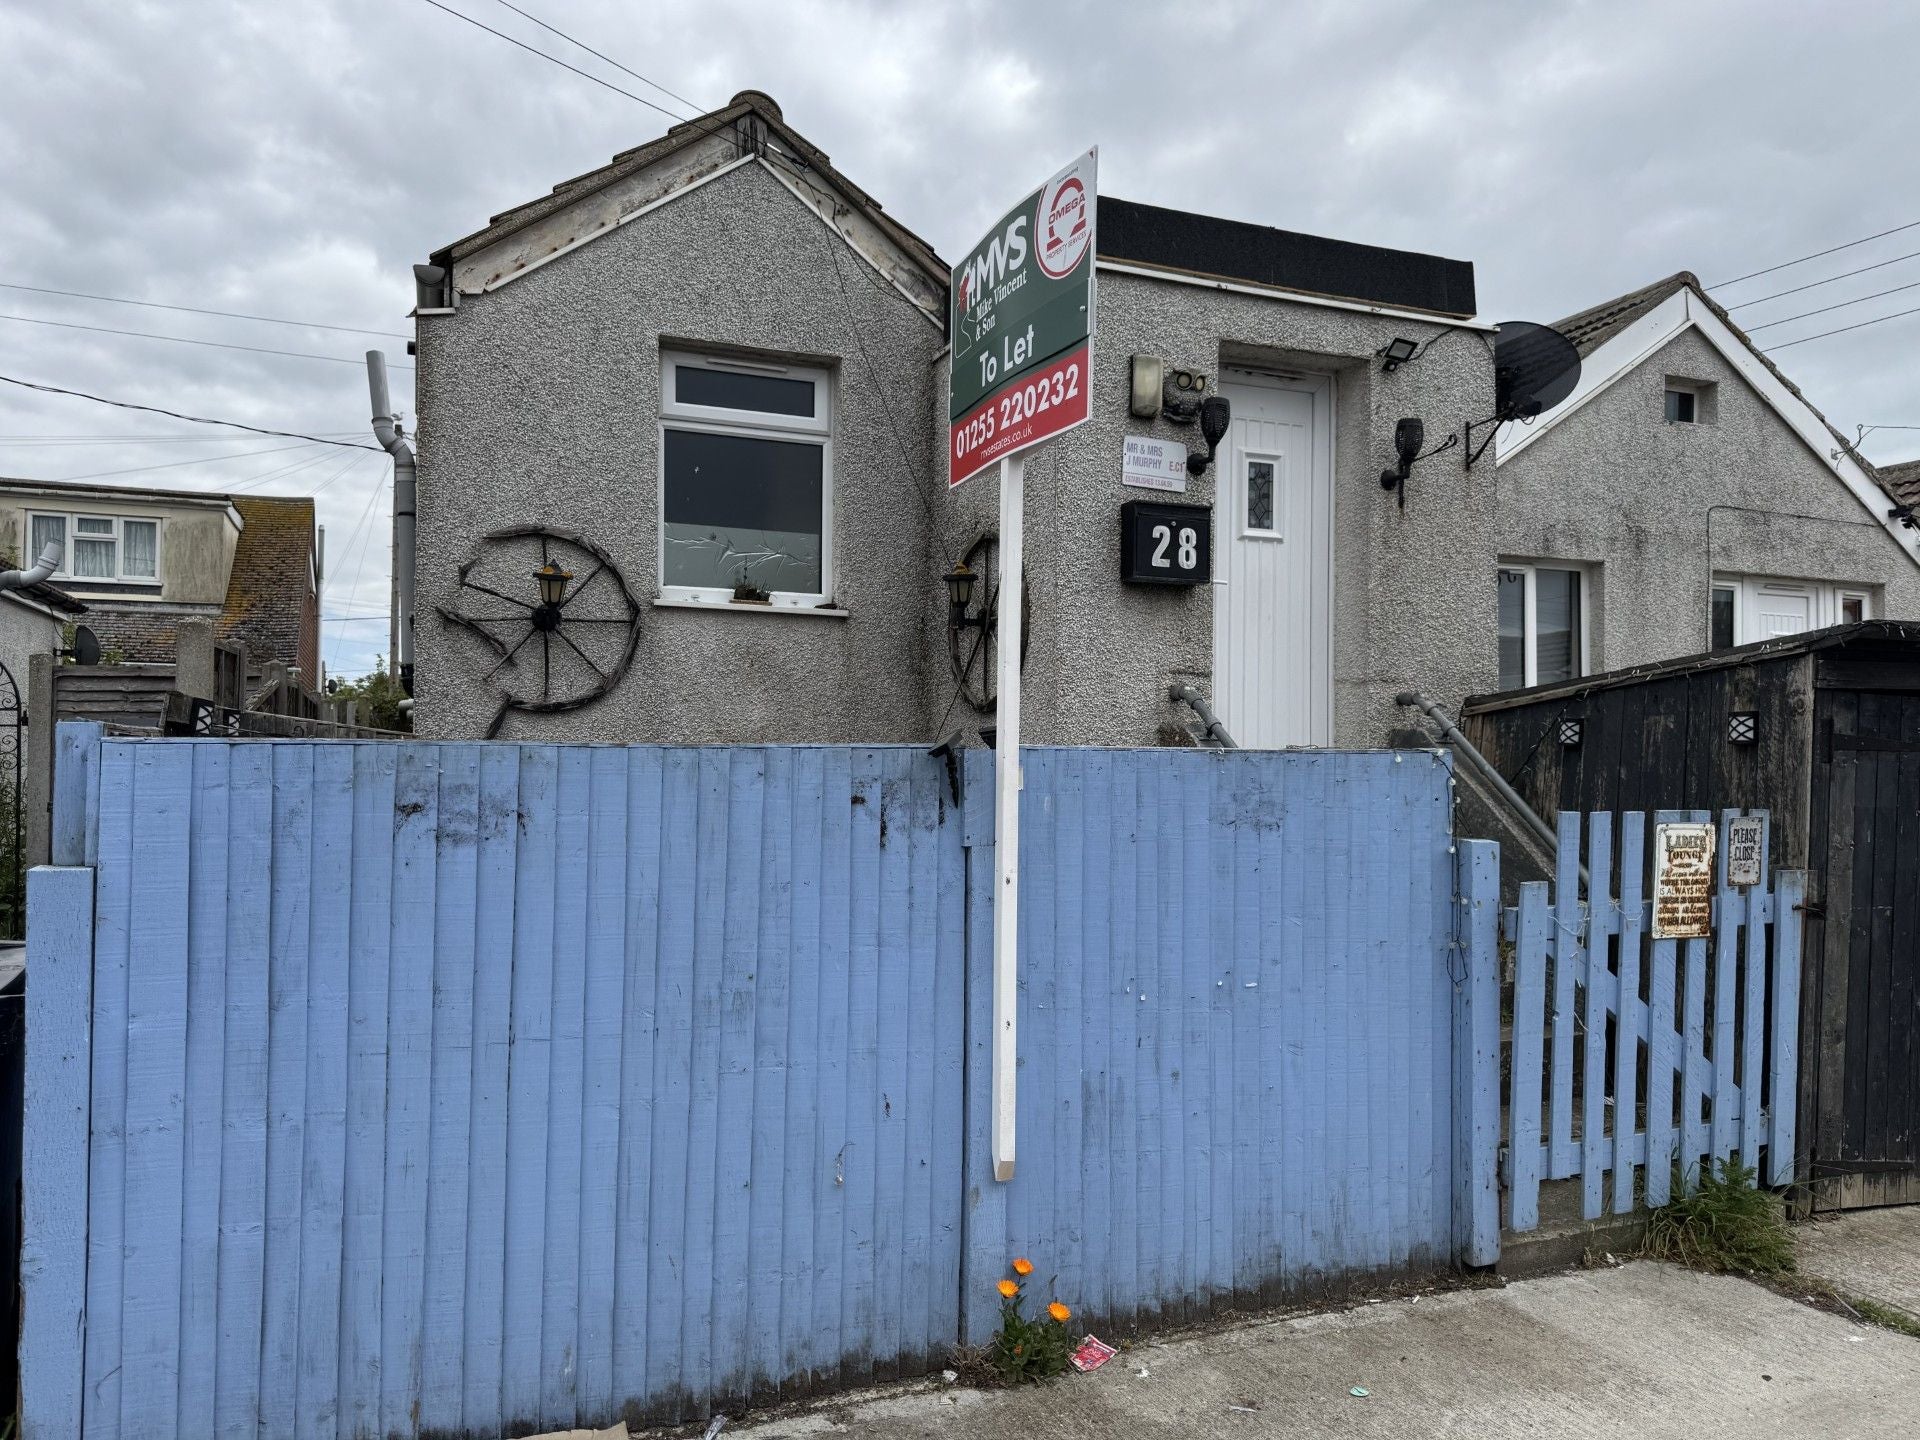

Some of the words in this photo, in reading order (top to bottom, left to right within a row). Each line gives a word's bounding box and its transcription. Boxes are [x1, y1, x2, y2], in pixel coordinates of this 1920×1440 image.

[1049, 193, 1085, 224] OMEGA
[976, 215, 1027, 303] MVS
[1047, 243, 1067, 260] PROPERTY
[1068, 230, 1087, 247] SERVICES
[976, 298, 993, 323] Mike
[994, 268, 1027, 305] Vincent
[976, 324, 981, 341] &
[982, 314, 996, 336] Son
[980, 350, 997, 387] To
[1004, 324, 1034, 371] Let
[956, 406, 995, 459] 01255
[1000, 363, 1079, 431] 220232
[981, 422, 1033, 460] mvsestates.co.uk
[1127, 442, 1138, 454] MR
[1140, 444, 1145, 455] &
[1147, 445, 1163, 457] MRS
[1126, 455, 1131, 466] J
[1133, 456, 1162, 469] MURPHY
[1151, 525, 1197, 569] 28
[1733, 827, 1758, 846] PLEASE
[1734, 845, 1755, 861] CLOSE
[1667, 886, 1694, 895] ALWAYS
